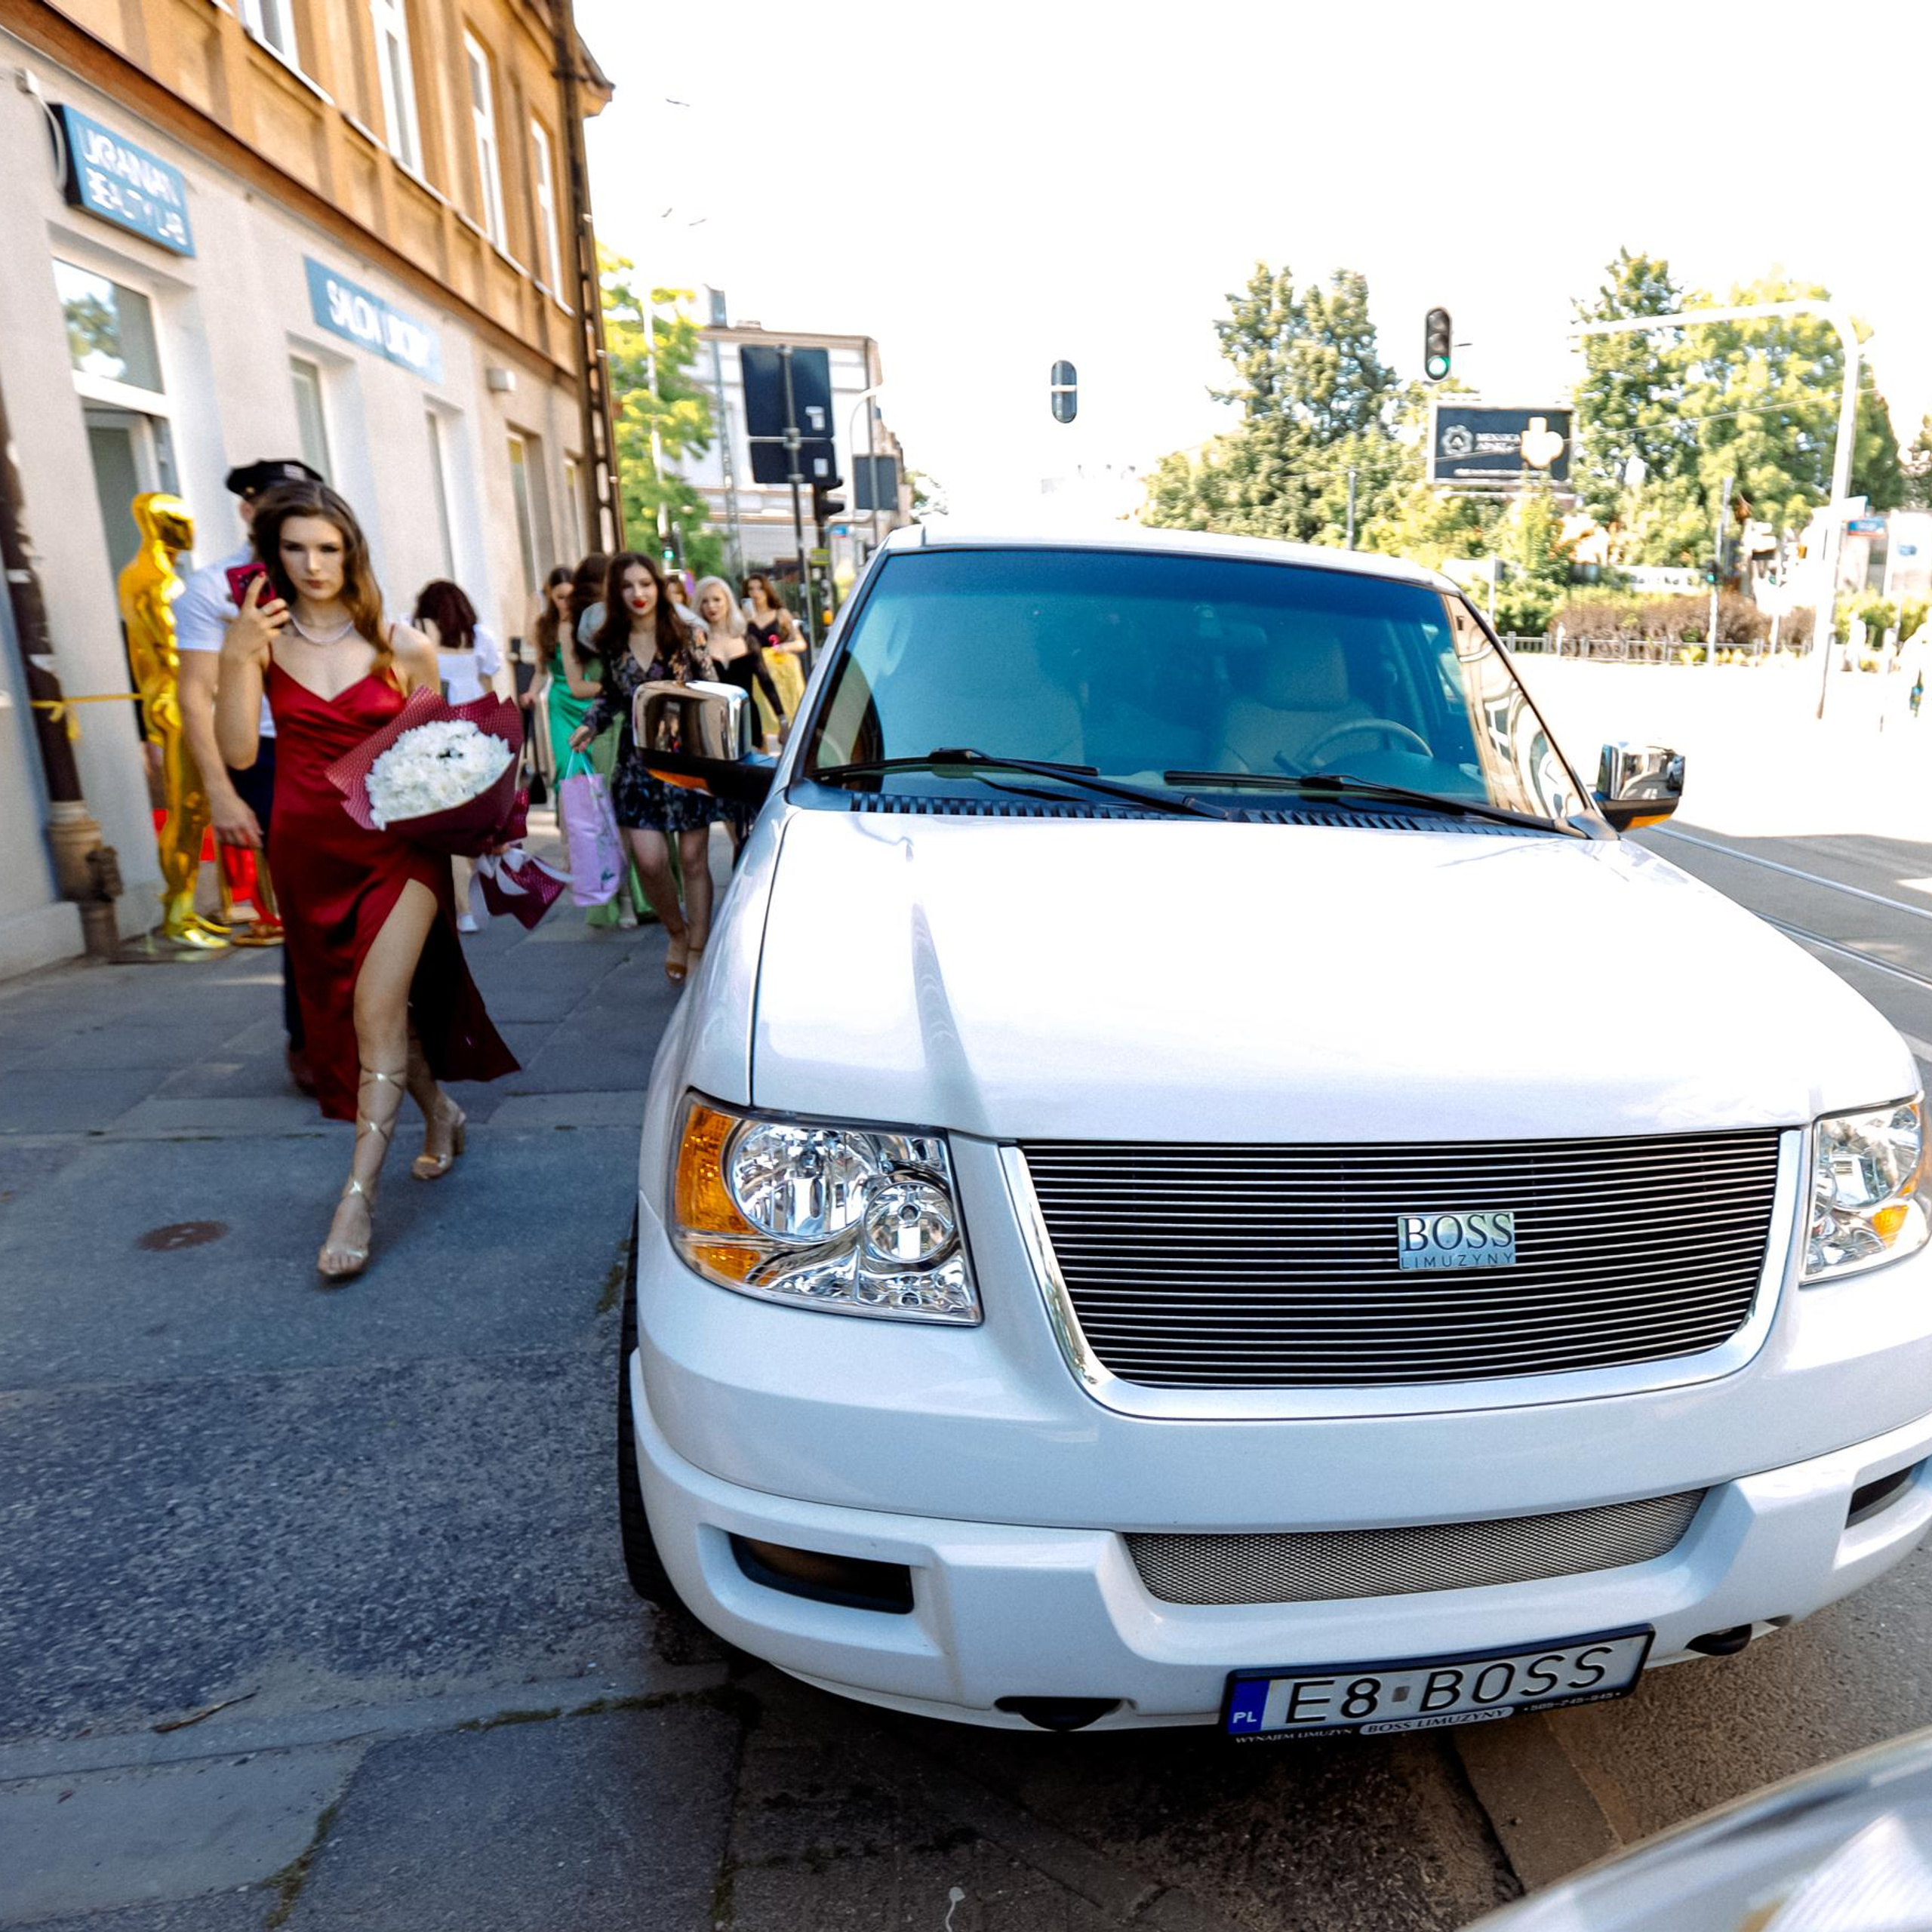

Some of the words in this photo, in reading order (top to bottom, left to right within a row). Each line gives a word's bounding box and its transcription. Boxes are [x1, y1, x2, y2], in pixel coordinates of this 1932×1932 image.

[1401, 1212, 1513, 1252] BOSS
[1401, 1252, 1513, 1269] LIMUZYNY
[1285, 1676, 1382, 1724] E8
[1420, 1646, 1614, 1711] BOSS
[1232, 1711, 1258, 1724] PL
[1367, 1721, 1411, 1734] BOSS
[1416, 1709, 1507, 1728] LIMUZYNY
